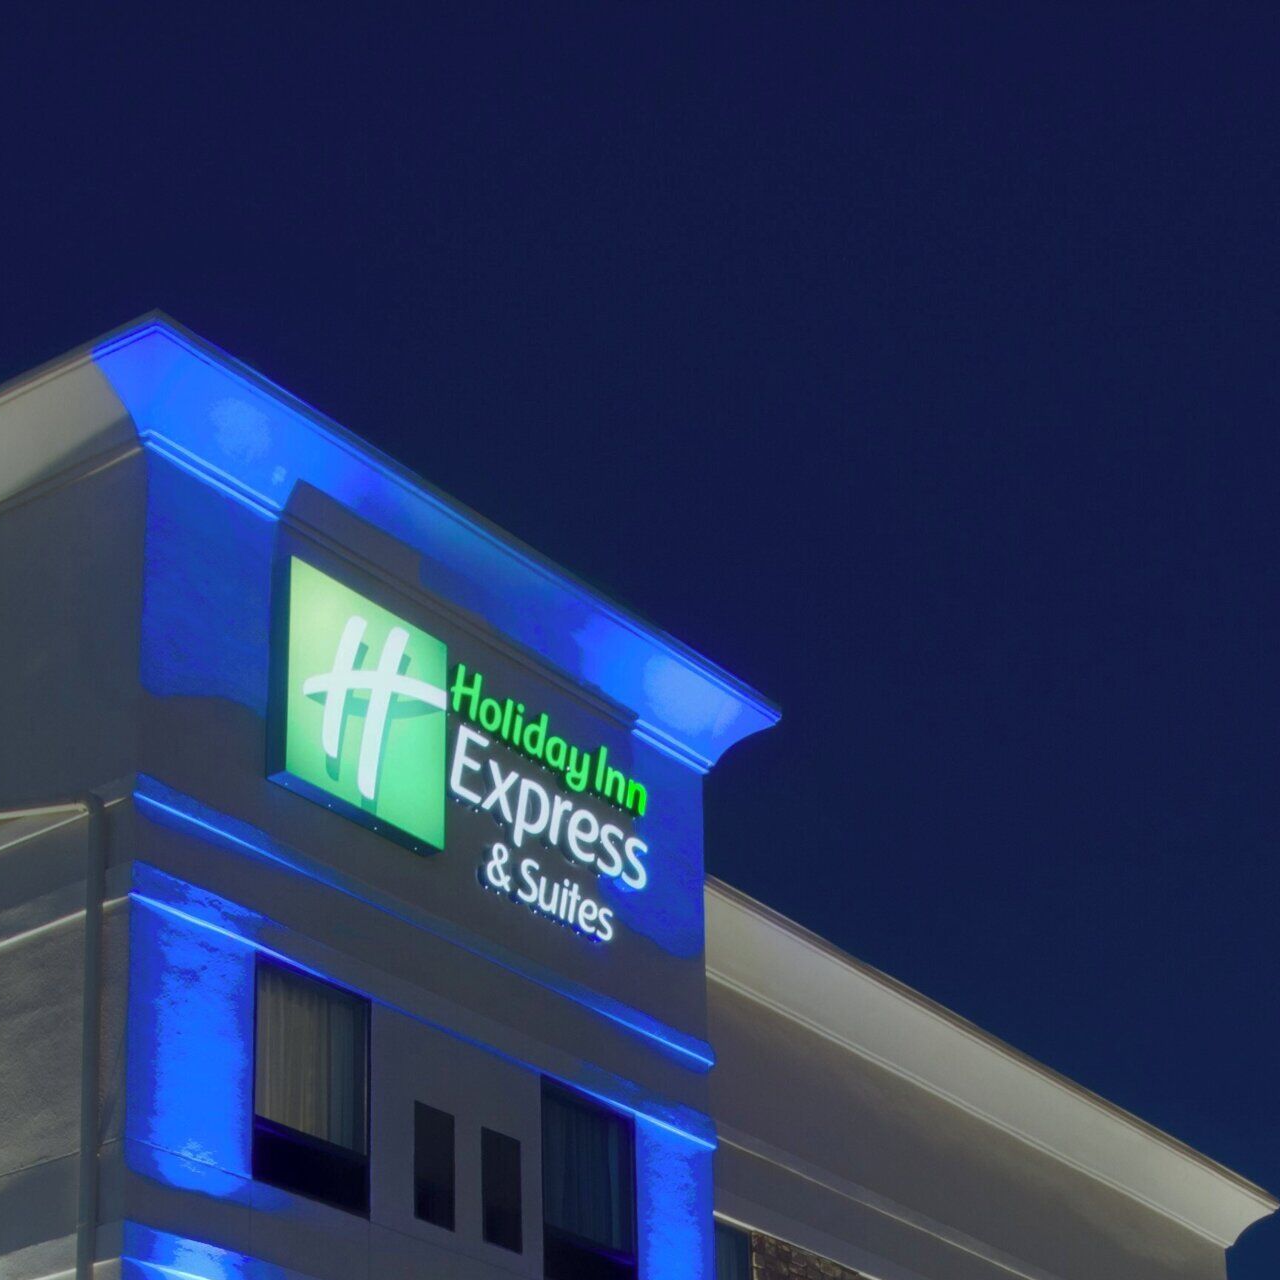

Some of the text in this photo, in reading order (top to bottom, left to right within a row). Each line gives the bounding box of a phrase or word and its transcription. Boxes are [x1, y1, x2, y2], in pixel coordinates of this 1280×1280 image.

[450, 724, 648, 890] Express
[451, 664, 647, 817] Holiday Inn
[486, 842, 614, 942] & Suites
